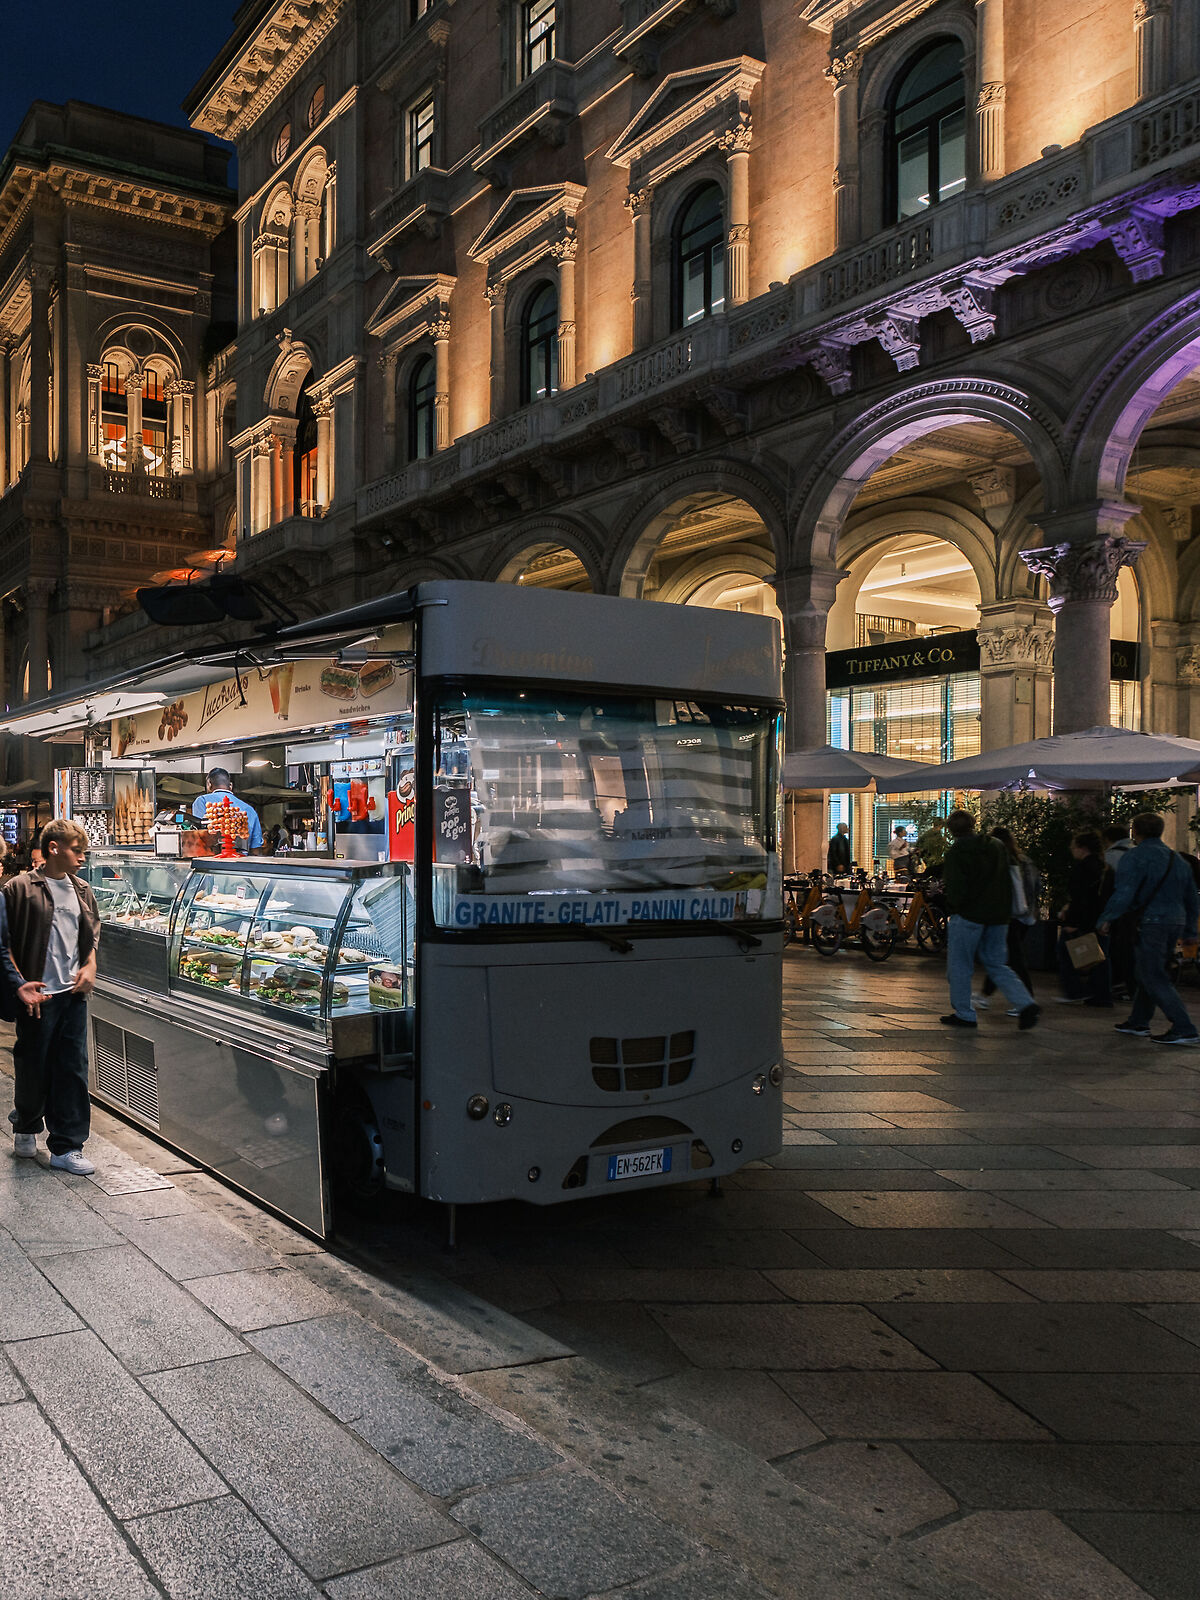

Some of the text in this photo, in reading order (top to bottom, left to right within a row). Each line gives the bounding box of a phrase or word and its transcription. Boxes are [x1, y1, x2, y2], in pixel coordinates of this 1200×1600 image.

[846, 654, 911, 675] TIFFANY
[912, 651, 925, 666] &
[441, 816, 460, 833] pop
[455, 901, 545, 925] GRANITE
[558, 900, 619, 924] GELATI
[631, 898, 685, 920] PANINI
[690, 897, 734, 920] CALDI
